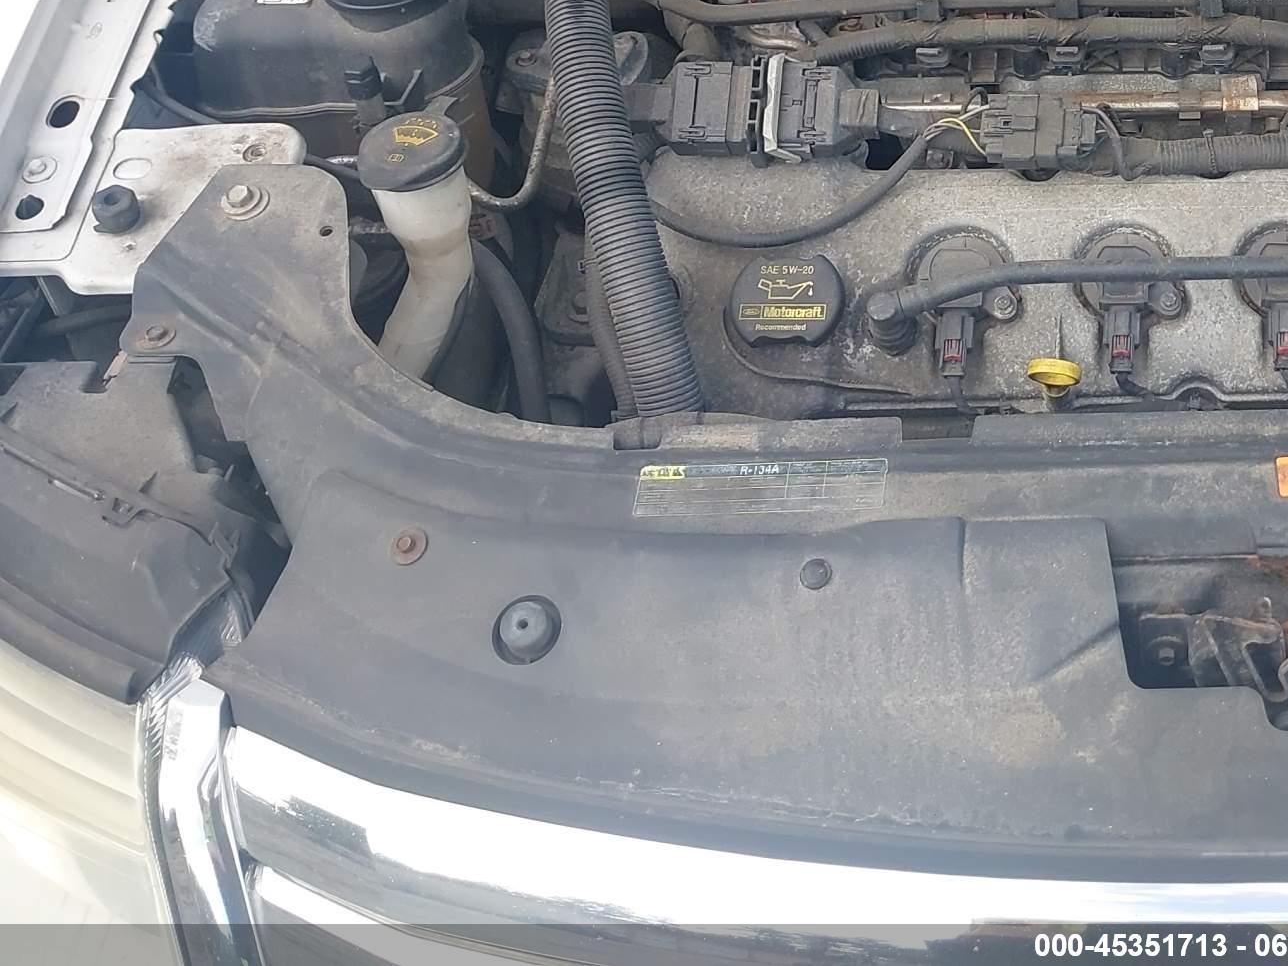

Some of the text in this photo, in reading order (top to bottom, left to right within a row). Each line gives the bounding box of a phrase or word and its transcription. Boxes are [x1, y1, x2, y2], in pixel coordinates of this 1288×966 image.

[760, 265, 815, 275] SAE 5W-20
[763, 306, 823, 318] Motorcraft
[755, 323, 807, 331] Recommended
[740, 464, 780, 475] R-134A
